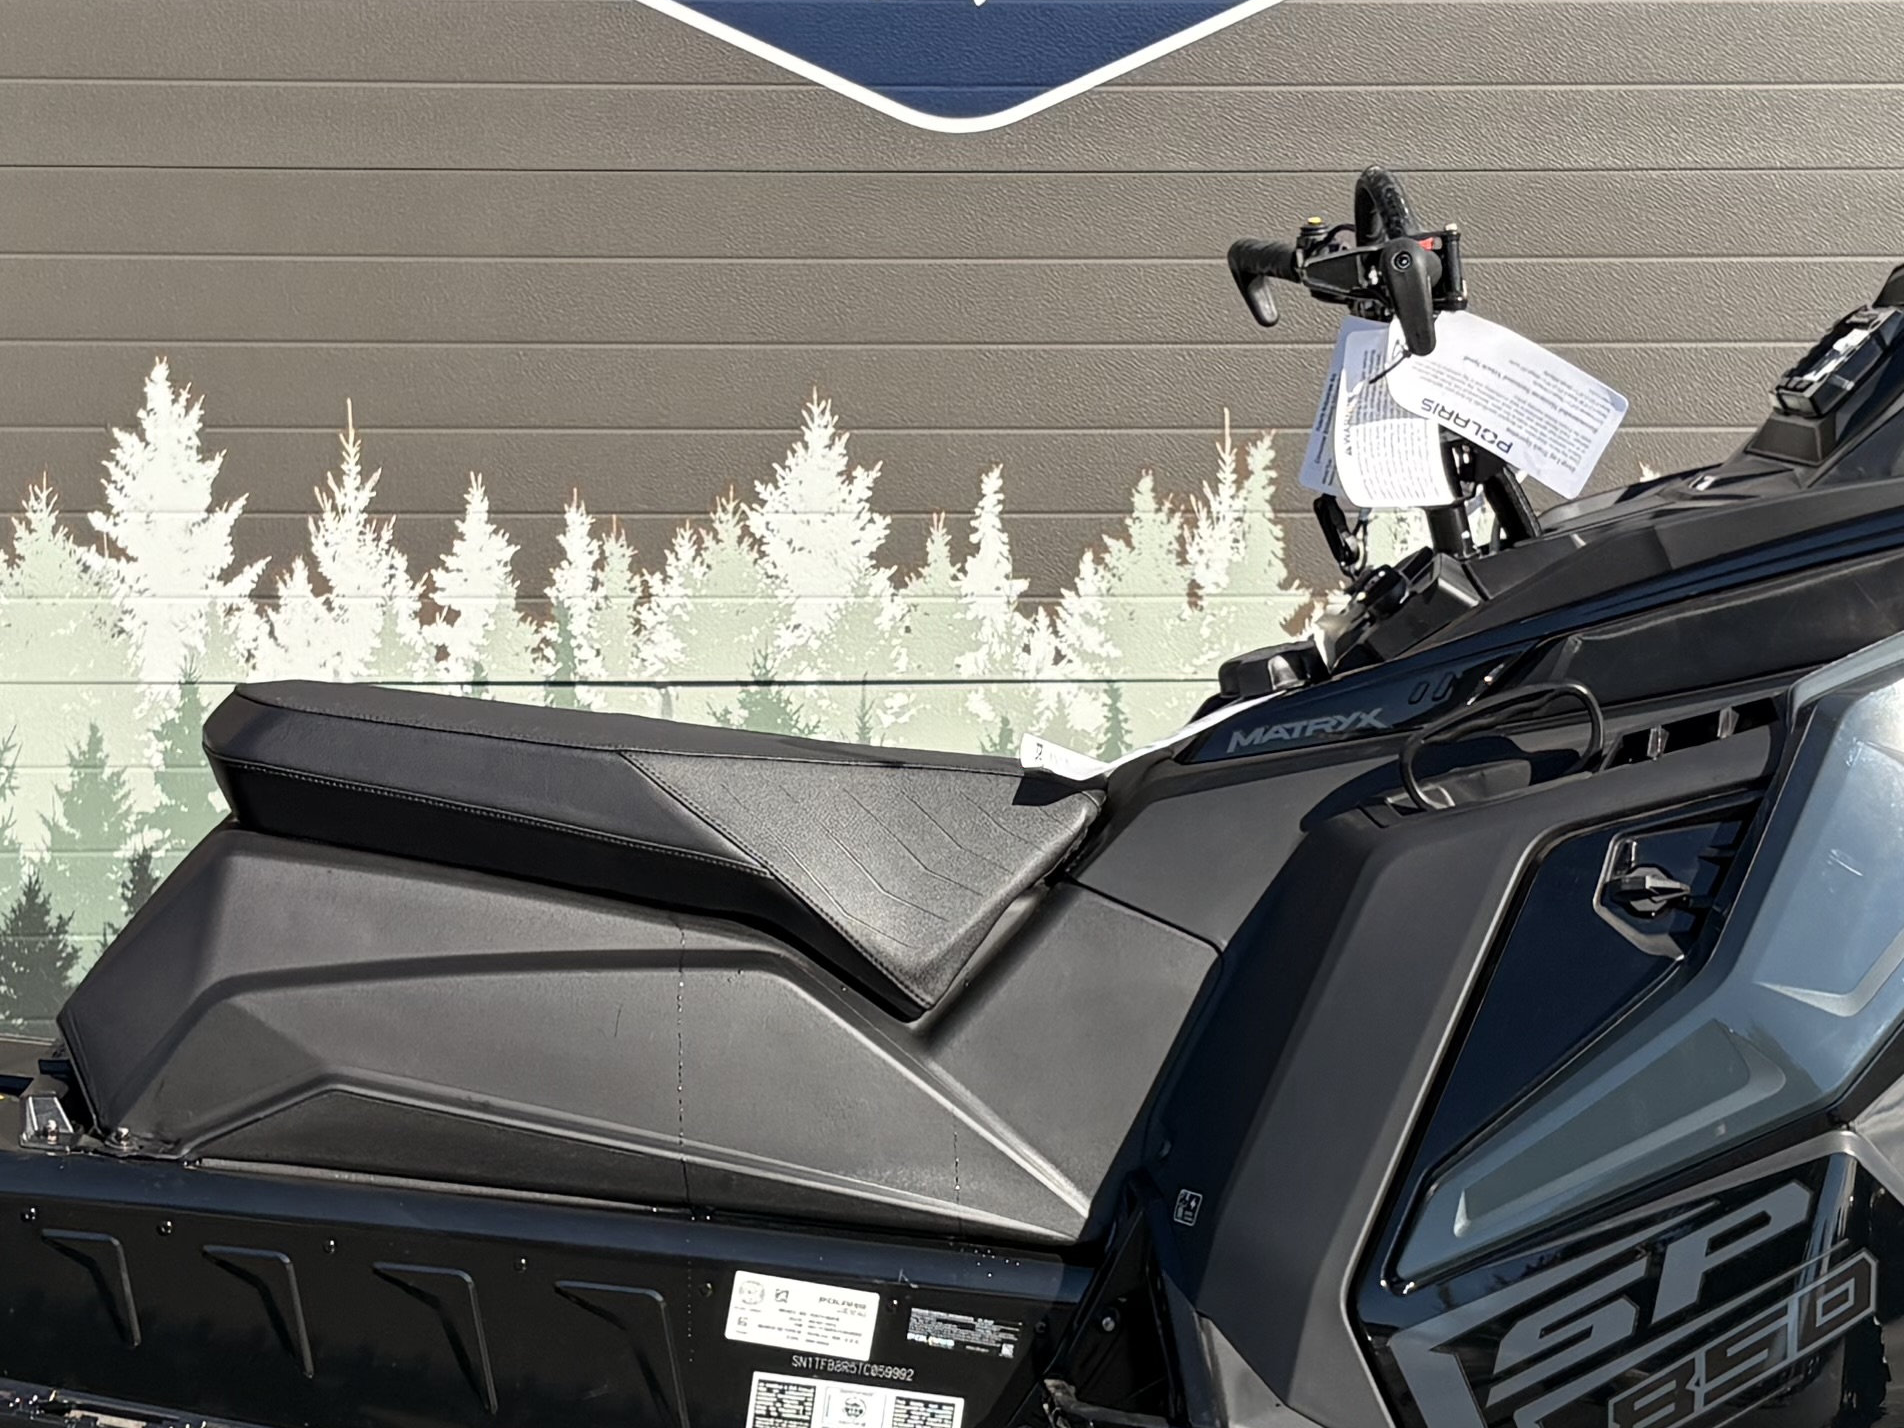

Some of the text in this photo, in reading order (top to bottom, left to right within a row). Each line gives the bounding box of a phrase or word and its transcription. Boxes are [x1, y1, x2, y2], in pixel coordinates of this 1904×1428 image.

[1421, 397, 1514, 454] POLARIS
[1226, 708, 1388, 754] MATRYX
[1485, 1180, 1814, 1409] SP
